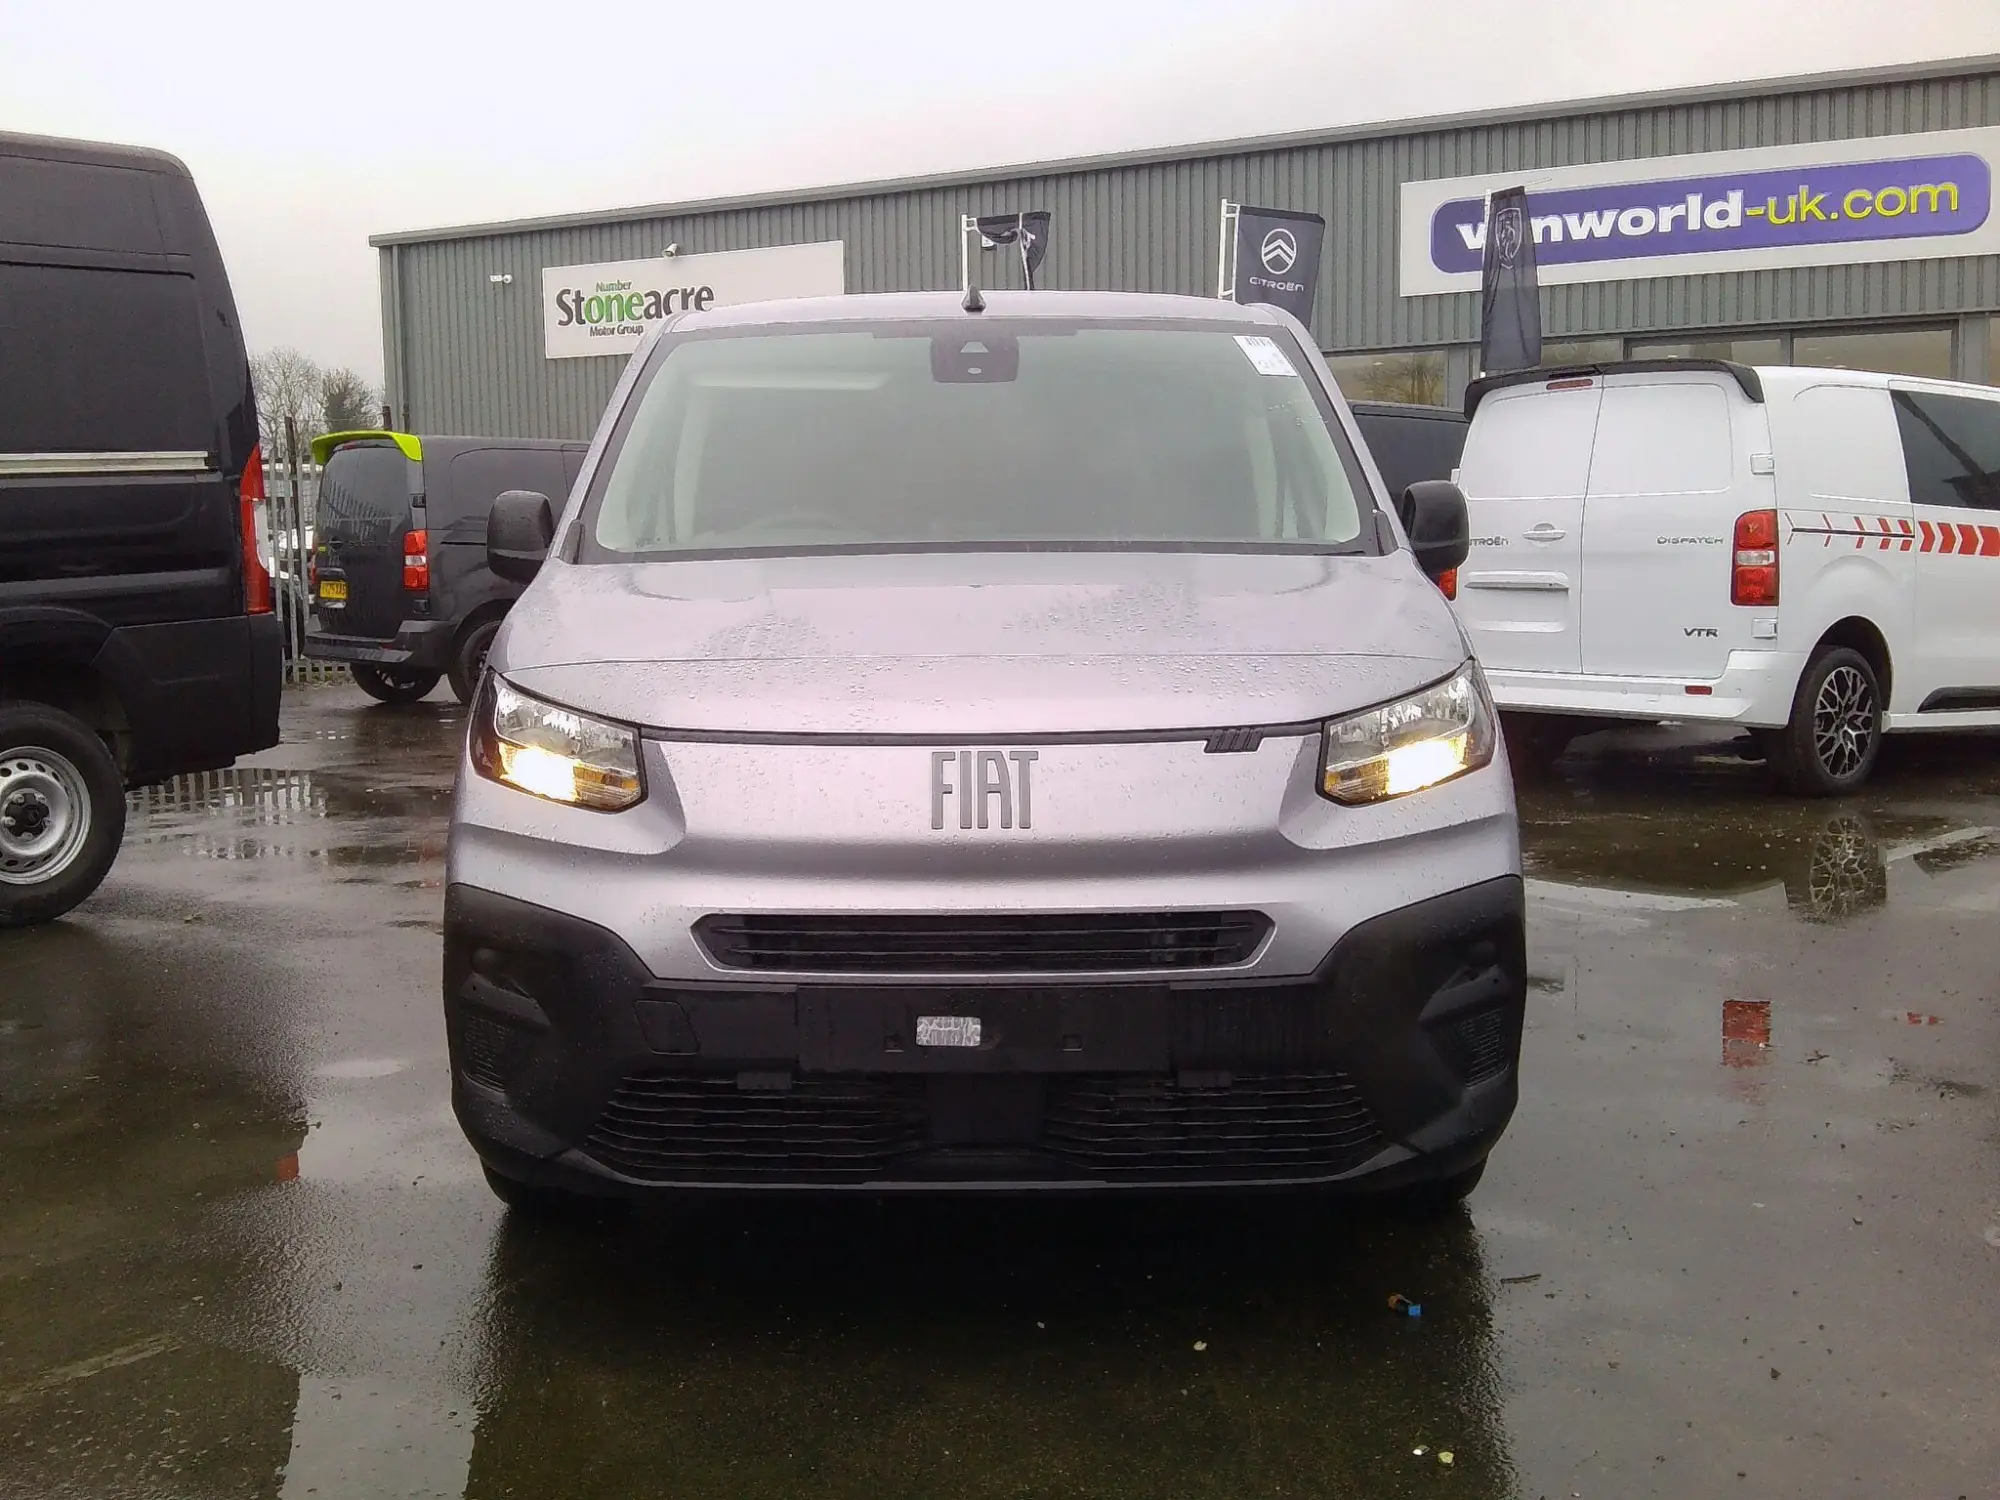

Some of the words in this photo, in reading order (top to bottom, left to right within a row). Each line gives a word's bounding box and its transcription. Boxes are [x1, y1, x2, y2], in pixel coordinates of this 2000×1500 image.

[1456, 181, 1960, 251] vnworld-uk.com
[595, 279, 632, 292] Number
[556, 286, 715, 327] Stoneacre
[589, 326, 616, 338] Motor
[616, 324, 643, 336] Group
[1656, 535, 1724, 545] DISPATCH
[1683, 627, 1718, 638] VTR
[931, 750, 1039, 829] FIAT
